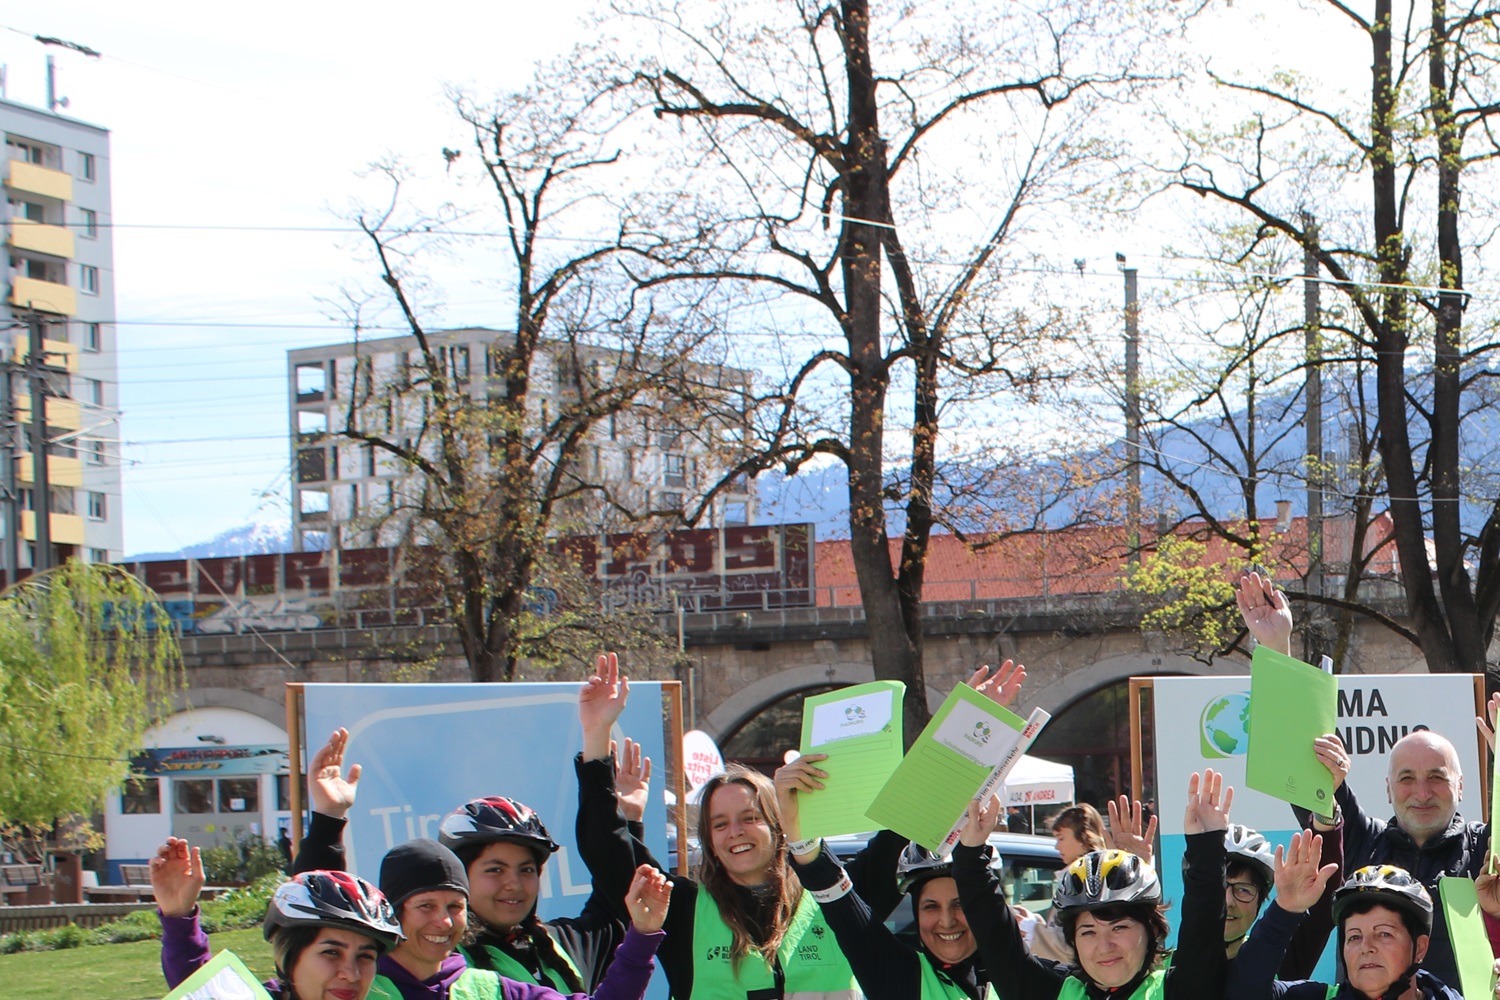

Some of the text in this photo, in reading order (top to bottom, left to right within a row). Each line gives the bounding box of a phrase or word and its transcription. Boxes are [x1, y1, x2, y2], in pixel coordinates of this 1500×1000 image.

[369, 804, 441, 844] Tir
[798, 944, 818, 954] LAND
[799, 952, 822, 961] TIROL
